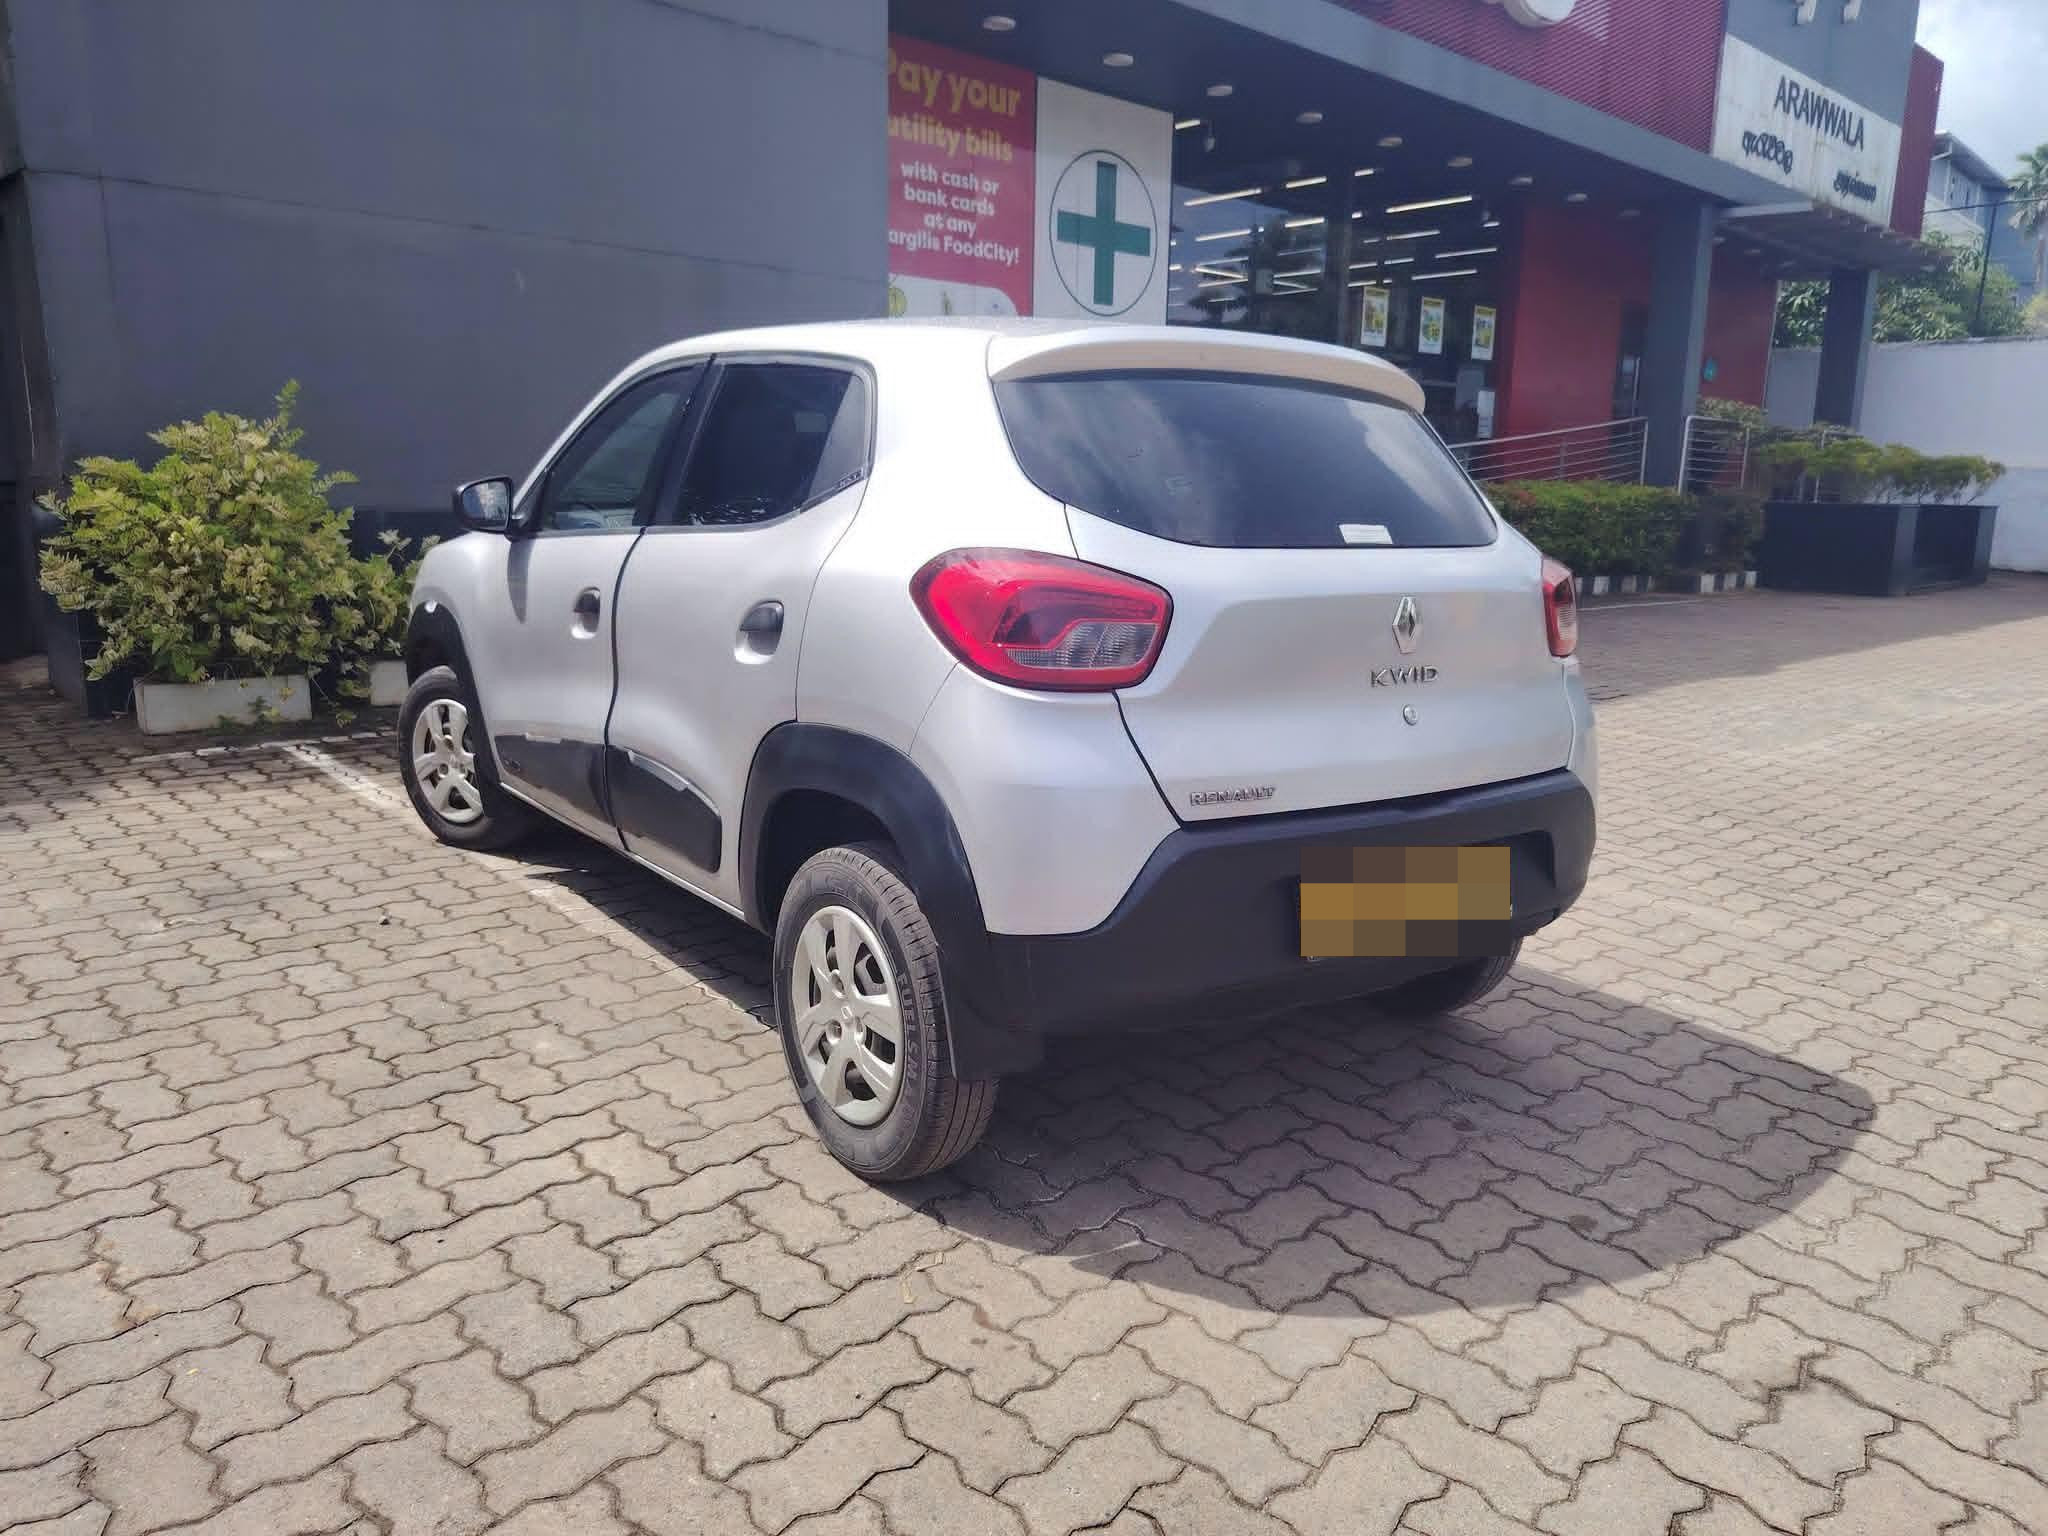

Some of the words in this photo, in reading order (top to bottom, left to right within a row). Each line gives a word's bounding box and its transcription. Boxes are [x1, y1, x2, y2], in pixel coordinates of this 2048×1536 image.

[946, 73, 1020, 118] your
[1774, 75, 1864, 151] ARAWWALA
[966, 127, 1013, 163] bills
[901, 161, 938, 184] with
[942, 167, 978, 192] cash
[982, 179, 1000, 196] or
[904, 183, 947, 209] bank
[952, 191, 994, 217] cards
[924, 213, 945, 229] at
[947, 218, 977, 238] any
[943, 235, 1019, 266] FoodCity!
[1370, 664, 1440, 688] KWID
[1190, 786, 1276, 806] RENAULT
